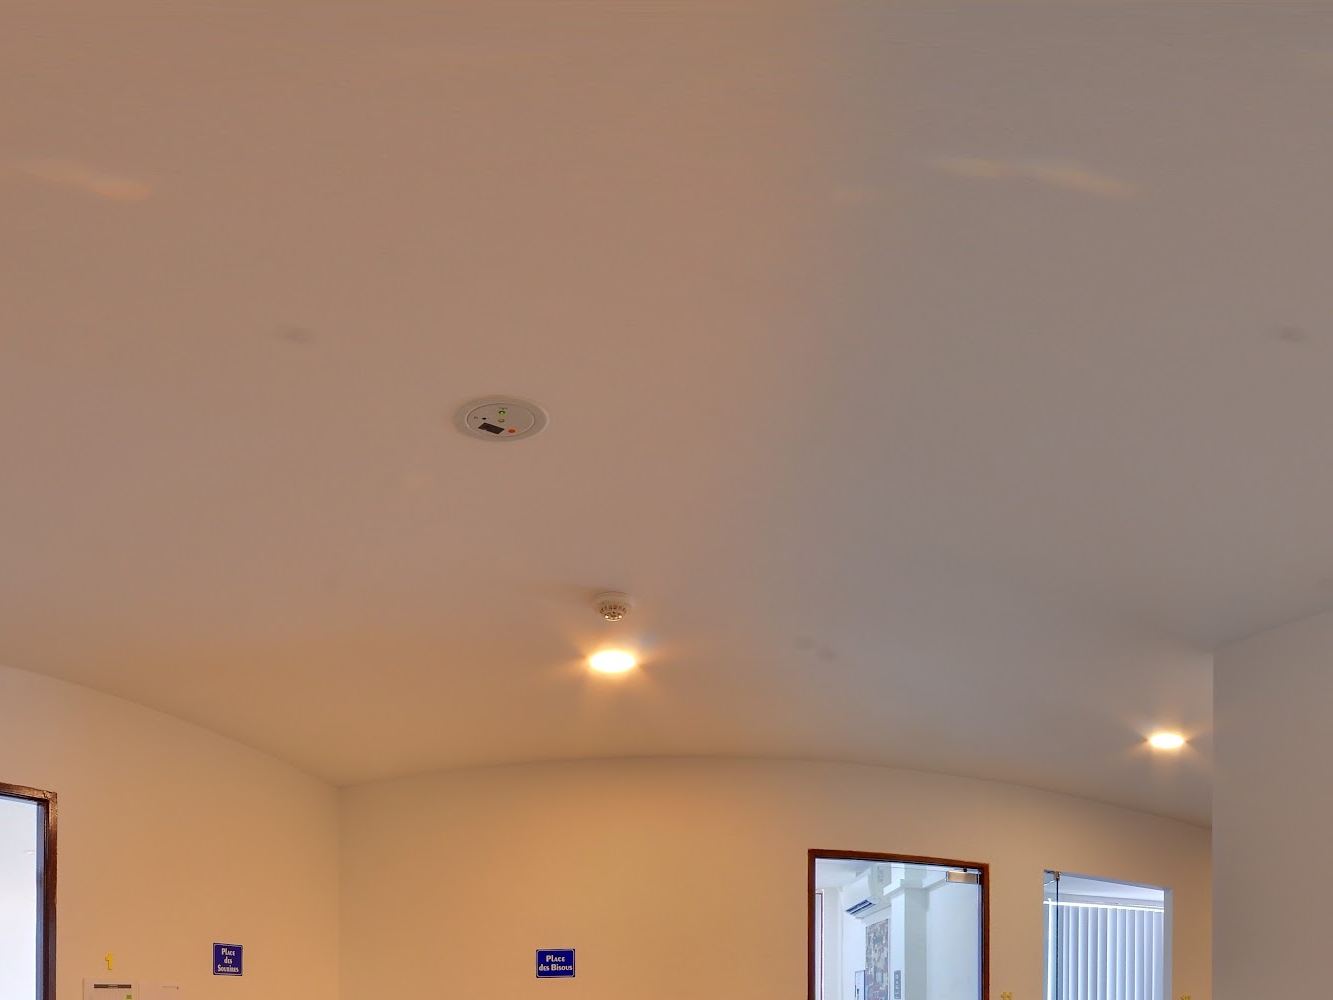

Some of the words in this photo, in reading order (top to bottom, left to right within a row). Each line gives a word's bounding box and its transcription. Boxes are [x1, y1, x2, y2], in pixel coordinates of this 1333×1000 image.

[105, 953, 114, 970] 1
[545, 954, 566, 962] Place
[538, 964, 550, 972] des
[551, 963, 573, 971] Bisous
